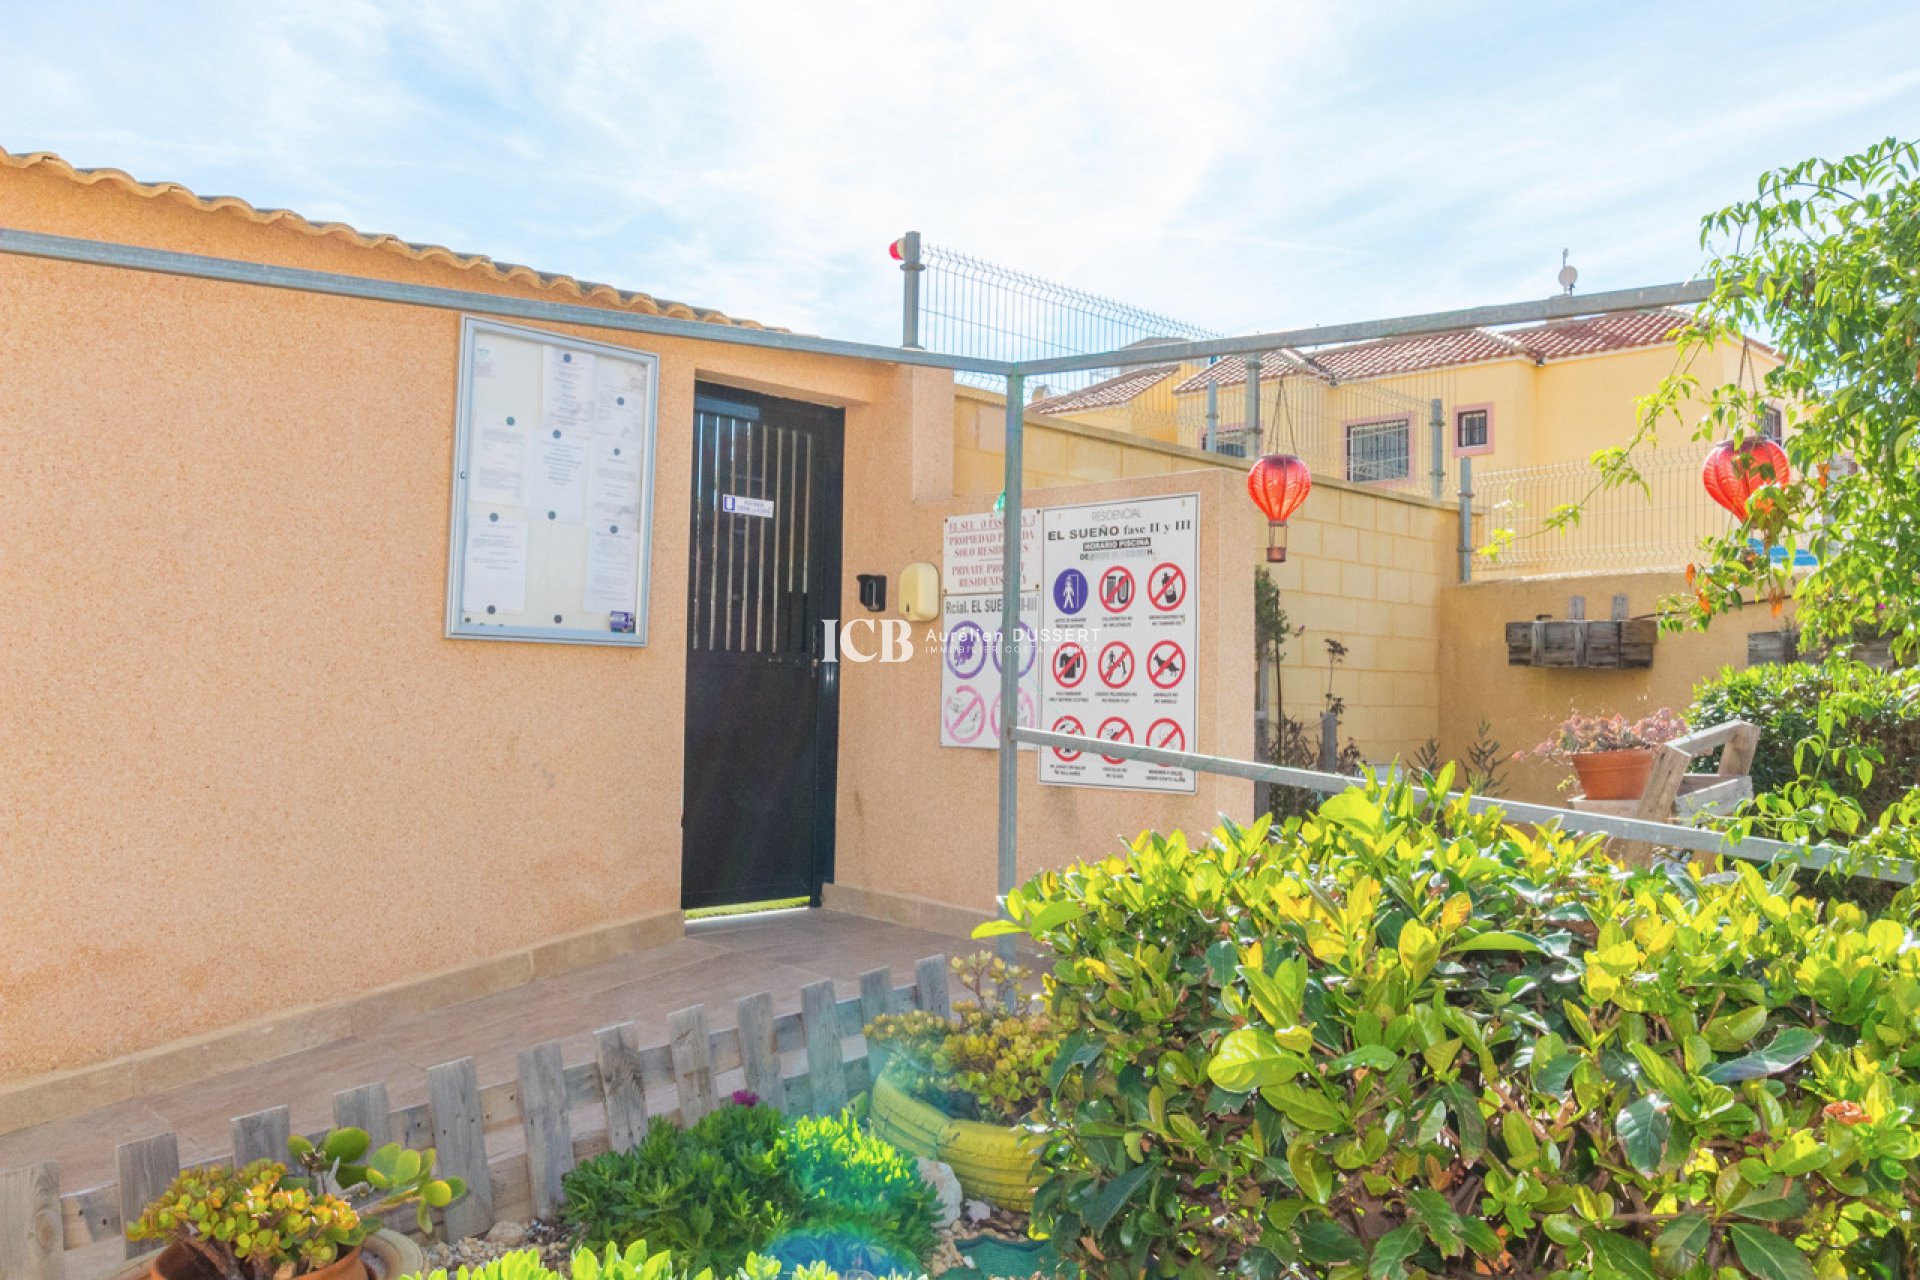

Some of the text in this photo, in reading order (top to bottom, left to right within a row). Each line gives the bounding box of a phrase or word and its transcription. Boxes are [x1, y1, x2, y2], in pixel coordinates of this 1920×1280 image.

[1048, 530, 1065, 541] EL
[1069, 525, 1120, 539] SUEÑO
[1123, 524, 1146, 536] fase
[1150, 523, 1159, 533] II
[1163, 524, 1171, 535] y
[1175, 520, 1191, 531] III
[971, 599, 981, 613] EL
